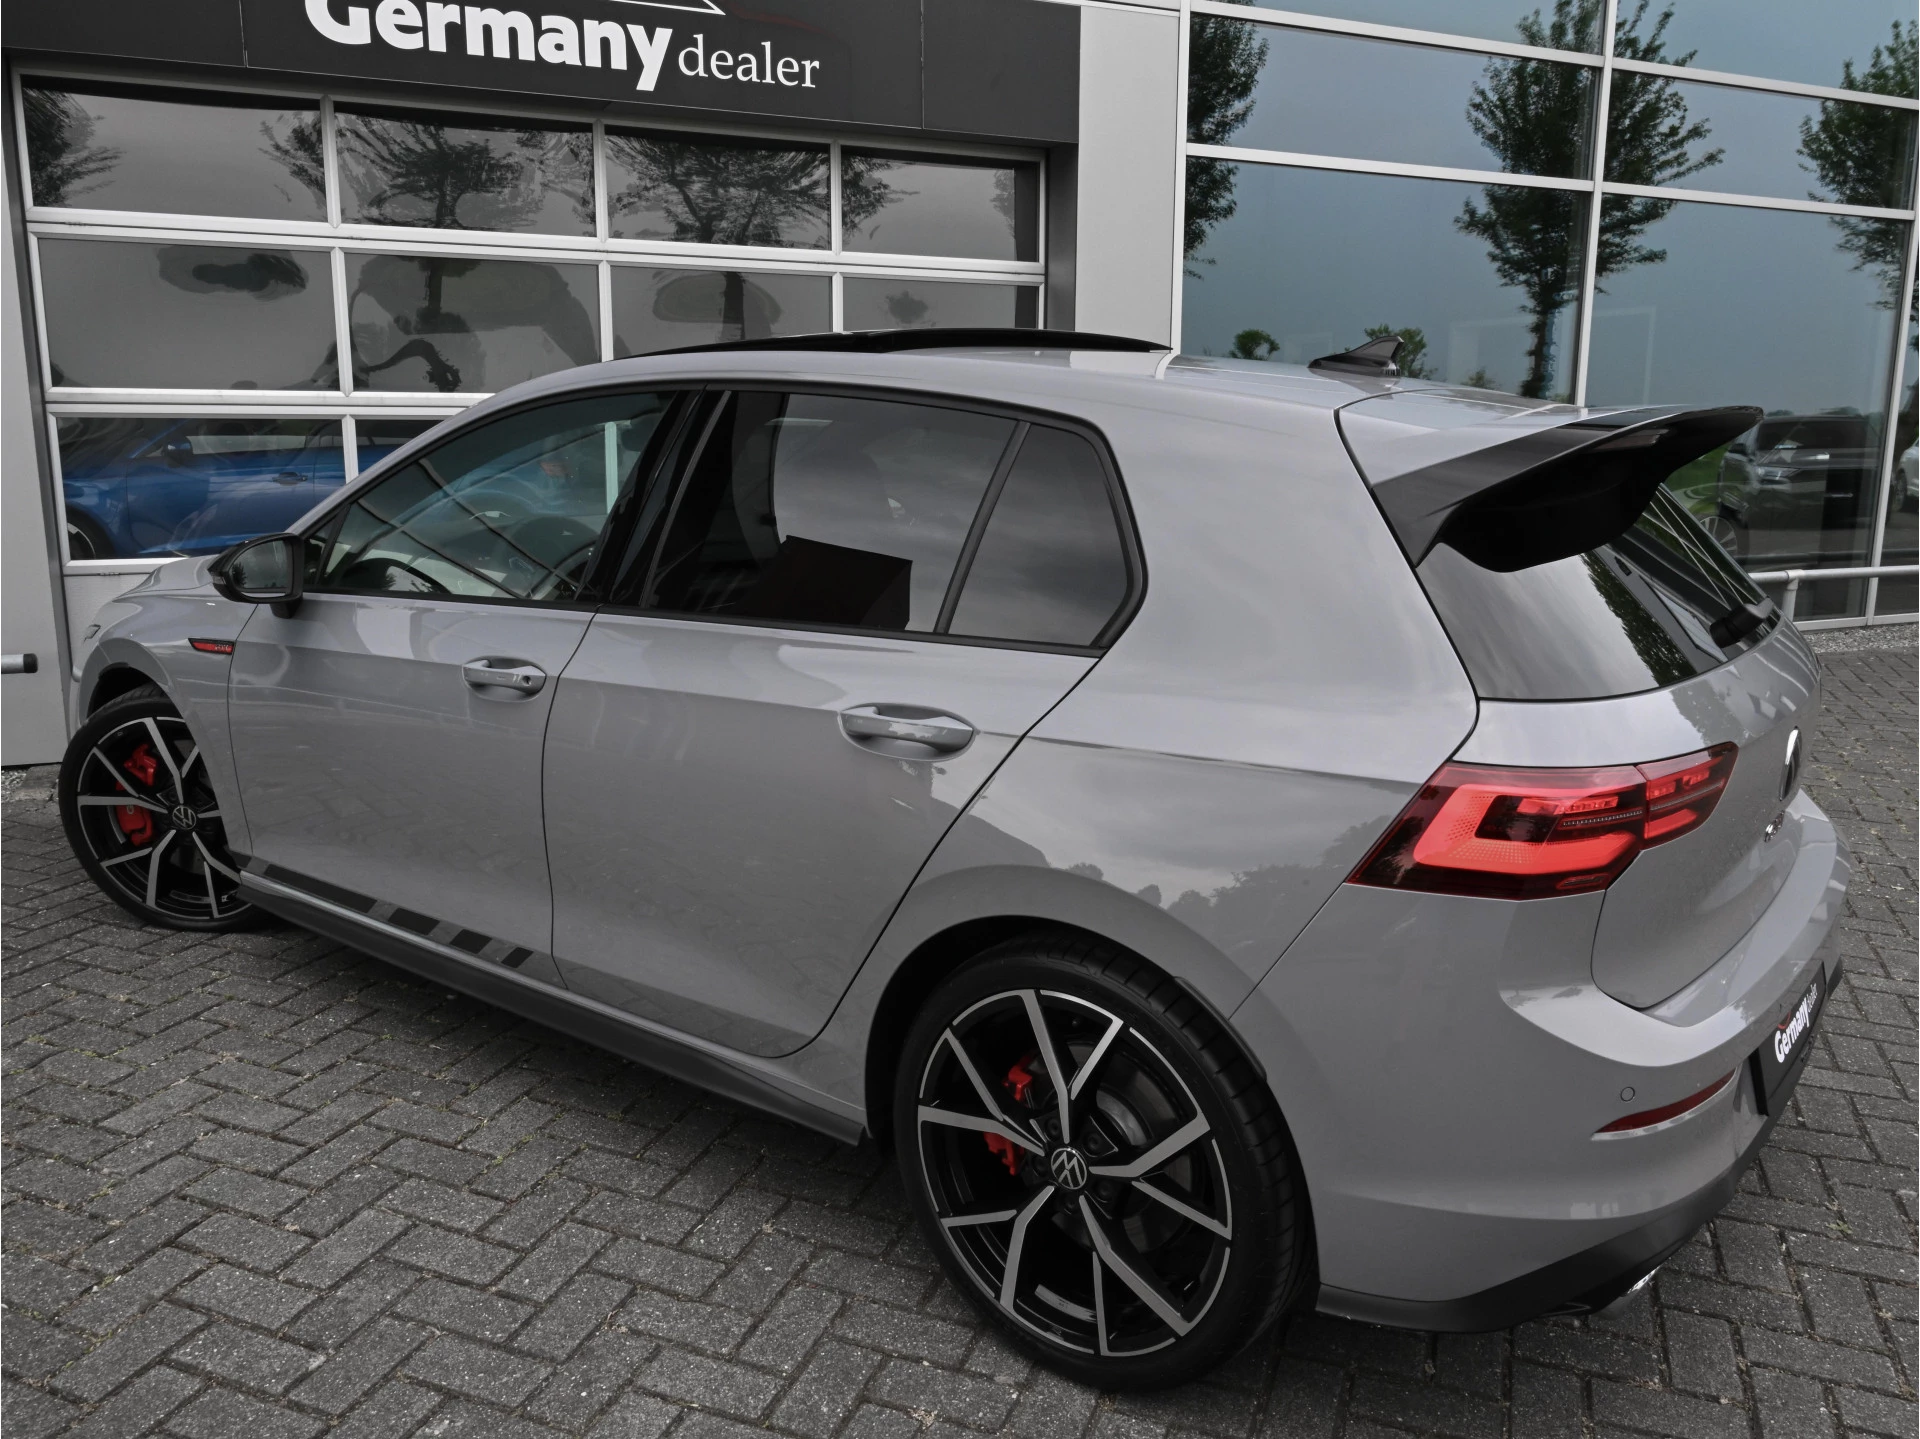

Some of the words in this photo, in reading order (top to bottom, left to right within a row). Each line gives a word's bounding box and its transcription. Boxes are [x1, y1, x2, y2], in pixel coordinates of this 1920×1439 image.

[304, 0, 673, 91] Germany
[678, 33, 820, 89] dealer
[1774, 997, 1810, 1063] Germany
